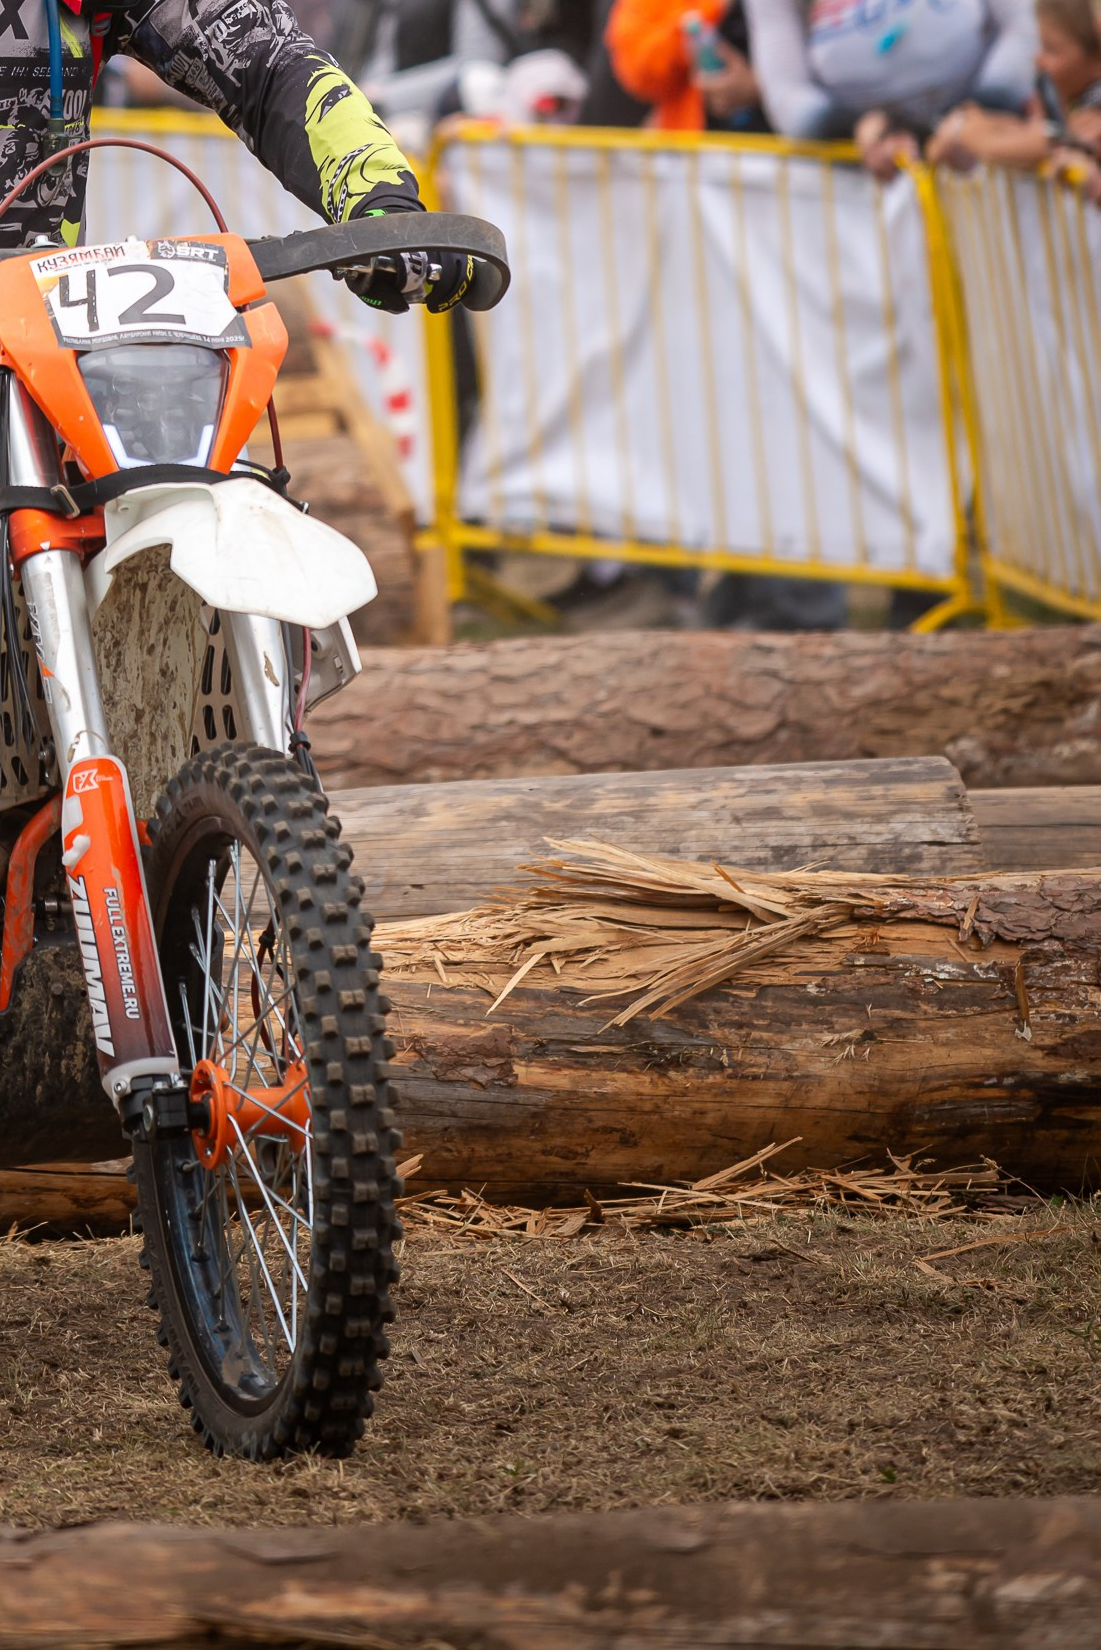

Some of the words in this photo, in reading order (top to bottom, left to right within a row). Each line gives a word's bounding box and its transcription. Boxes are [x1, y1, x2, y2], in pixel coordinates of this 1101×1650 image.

[176, 245, 219, 260] SRT
[59, 264, 186, 332] 42
[68, 874, 116, 1058] ZUUMAV
